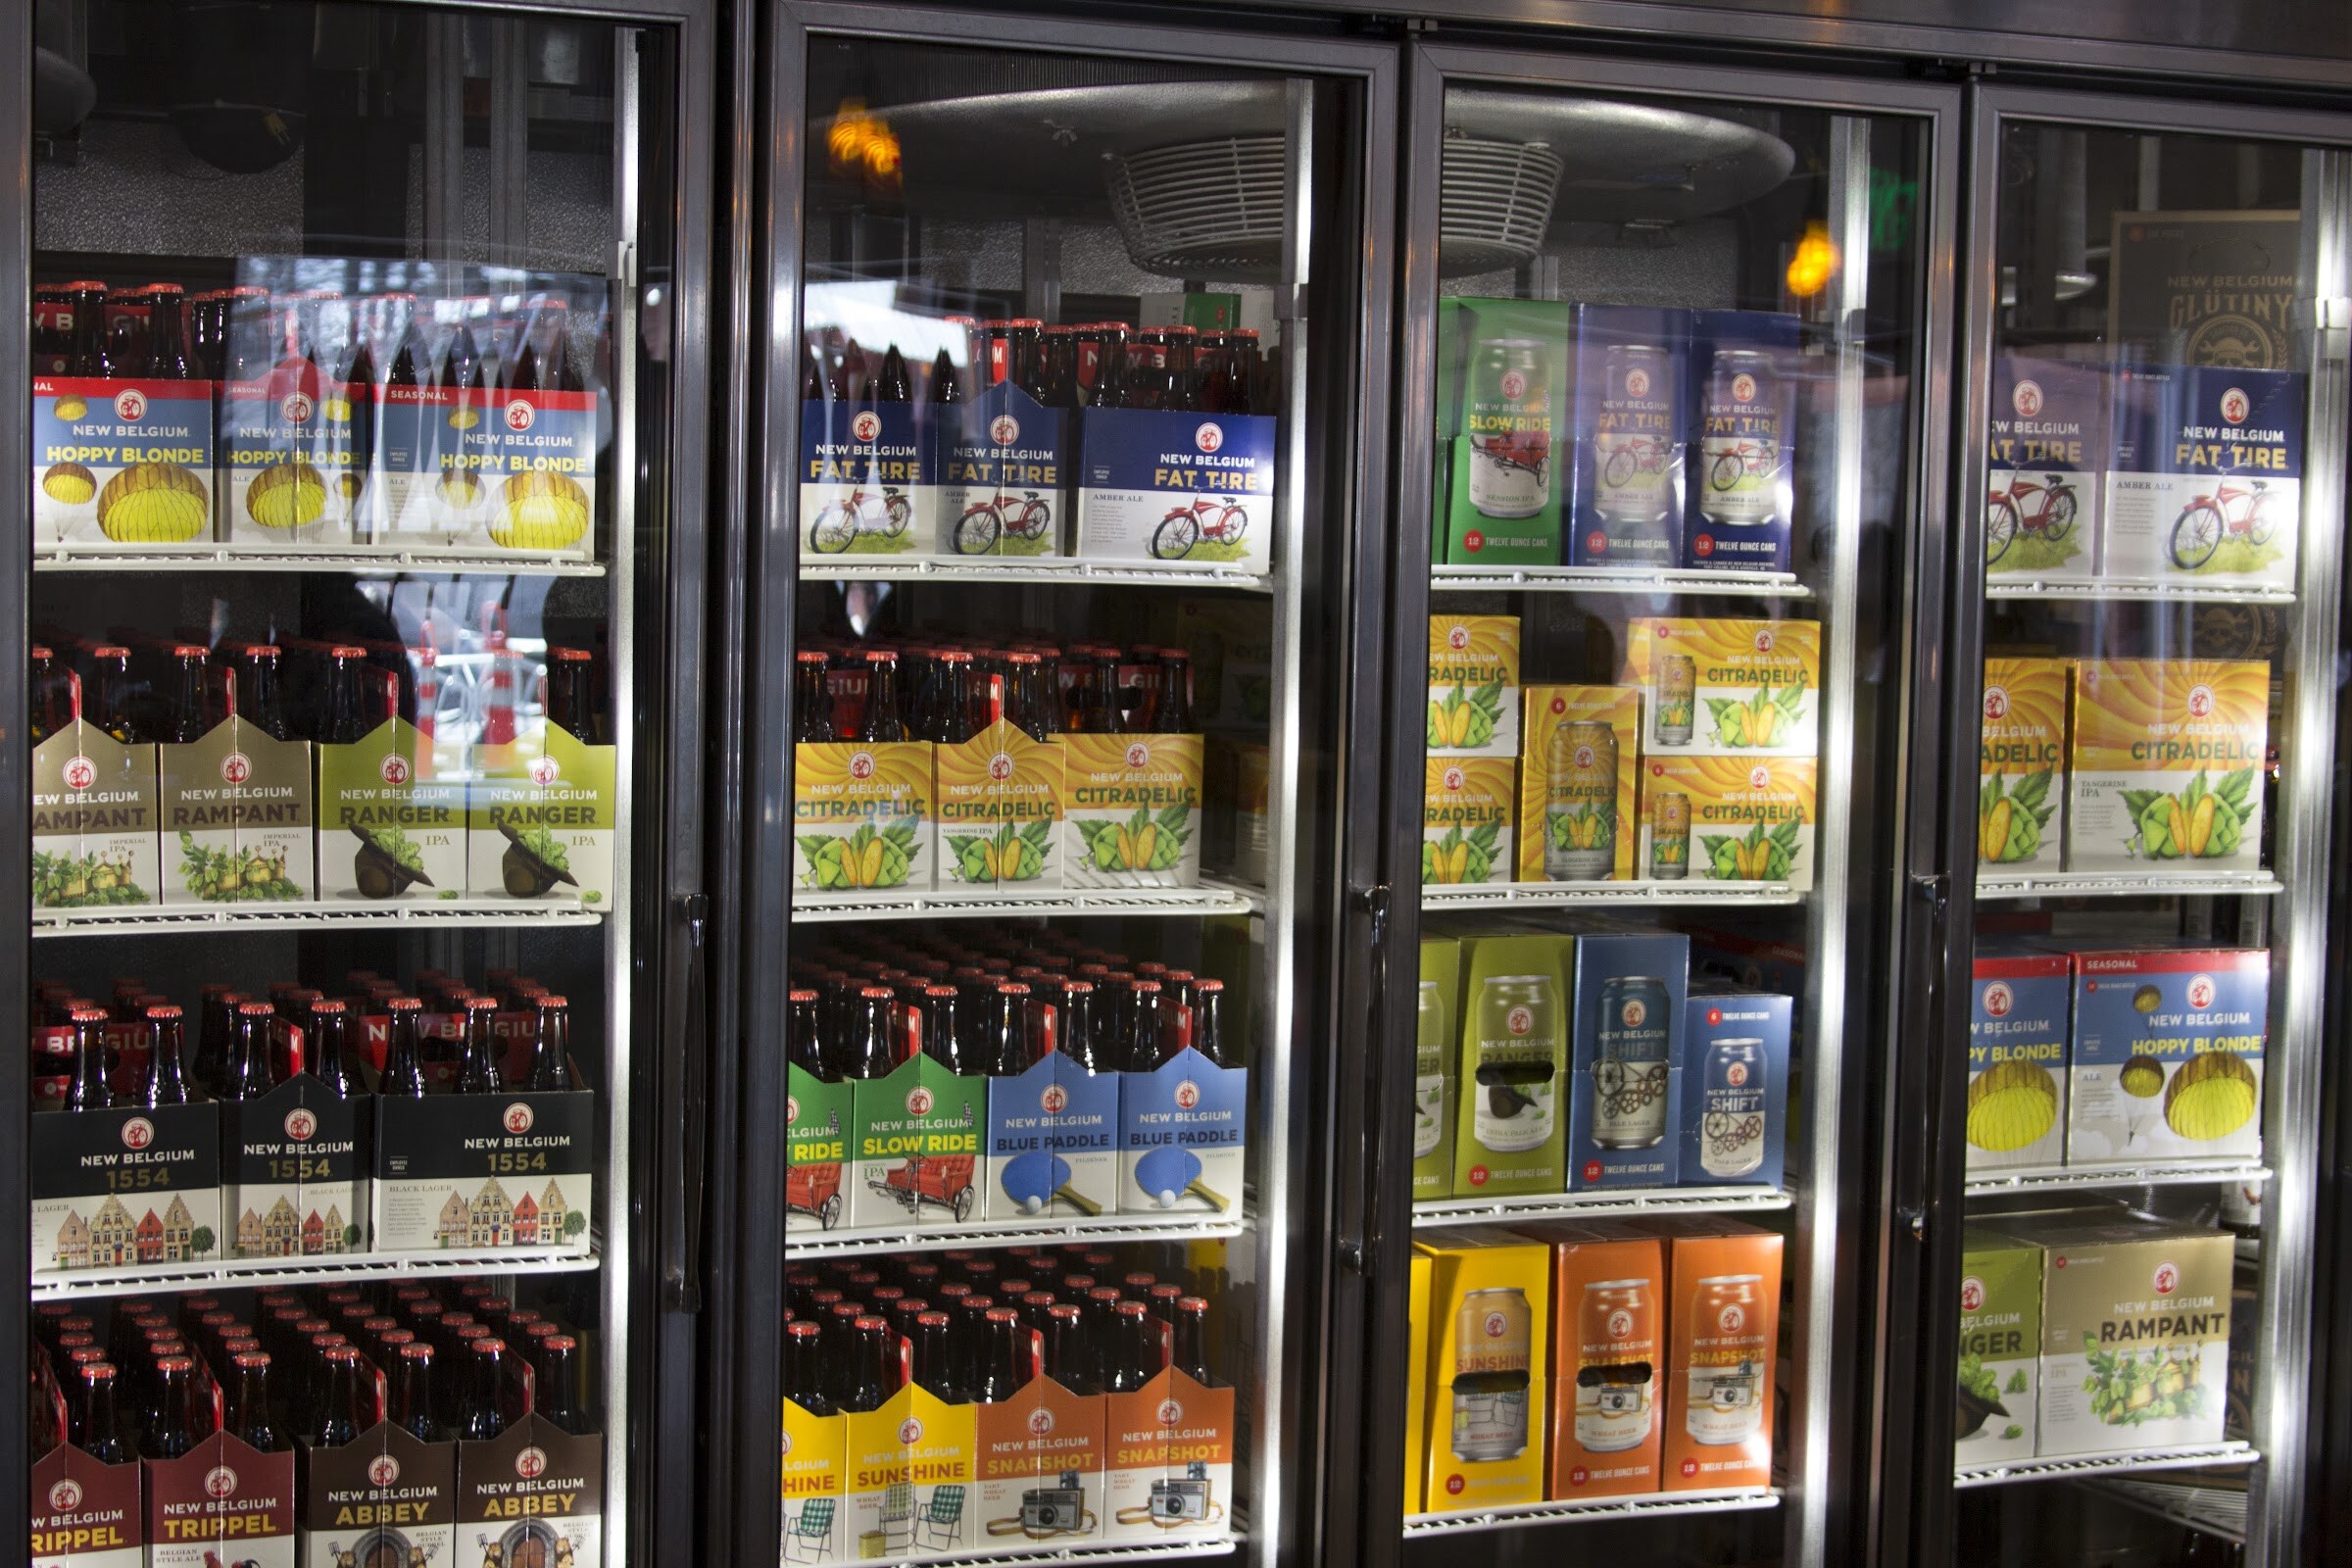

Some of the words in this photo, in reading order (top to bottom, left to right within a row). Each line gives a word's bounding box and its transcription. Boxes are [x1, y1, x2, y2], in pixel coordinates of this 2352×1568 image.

[2169, 276, 2205, 287] NEW
[2213, 275, 2292, 286] BELGIUM
[2170, 290, 2292, 332] GLÜTINY
[390, 390, 448, 401] SEASONAL
[1470, 415, 1513, 431] SLOW
[1516, 416, 1550, 432] RIDE
[1599, 413, 1628, 427] FAT
[1636, 413, 1671, 429] TIRE
[73, 425, 111, 436] NEW
[117, 425, 189, 437] BELGIUM
[240, 427, 277, 438] NEW
[282, 427, 351, 439] BELGIUM
[2183, 426, 2217, 439] NEW
[2222, 428, 2284, 441] BELGIUM
[465, 433, 502, 445] NEW
[505, 434, 573, 447] BELGIUM
[47, 446, 117, 464] HOPPY
[122, 448, 204, 464] BLONDE
[815, 444, 851, 456] NEW
[854, 444, 916, 457] BELGIUM
[954, 447, 987, 459] NEW
[991, 448, 1054, 461] BELGIUM
[2176, 444, 2222, 466] FAT
[2231, 446, 2286, 470] TIRE
[441, 454, 506, 469] HOPPY
[510, 456, 586, 472] BLONDE
[1160, 453, 1193, 465] NEW
[1196, 455, 1255, 467] BELGIUM
[810, 460, 856, 478] FAT
[864, 460, 920, 479] TIRE
[948, 463, 993, 481] FAT
[999, 465, 1056, 483] TIRE
[1154, 468, 1197, 488] FAT
[1205, 470, 1257, 490] TIRE
[2117, 481, 2151, 490] AMBER
[1467, 537, 1479, 546] 12
[1486, 537, 1508, 547] TWELVE
[1510, 538, 1530, 547] OUNCE
[1532, 538, 1547, 547] CANS
[1715, 541, 1739, 550] TWELVE
[1740, 542, 1760, 551] OUNCE
[1760, 542, 1777, 551] CANS
[1754, 656, 1800, 664] BELGIUM
[1707, 667, 1809, 684] CITRADELIC
[2132, 741, 2259, 760] CITRADELIC
[1091, 773, 1122, 782] NEW
[1125, 772, 1183, 782] BELGIUM
[181, 789, 218, 801] NEW
[221, 787, 293, 800] BELGIUM
[341, 789, 377, 800] NEW
[381, 788, 450, 800] BELGIUM
[491, 790, 525, 801] NEW
[529, 789, 598, 801] BELGIUM
[811, 785, 844, 795] NEW
[848, 784, 911, 795] BELGIUM
[951, 785, 983, 795] NEW
[988, 784, 1049, 795] BELGIUM
[1075, 787, 1196, 804] CITRADELIC
[2081, 788, 2099, 797] IPA
[173, 804, 301, 825] RAMPANT
[340, 806, 450, 824] RANGER
[490, 806, 596, 824] RANGER
[795, 799, 926, 816] CITRADELIC
[943, 802, 1054, 817] CITRADELIC
[1703, 805, 1804, 819] CITRADELIC
[425, 835, 450, 846] IPA
[572, 835, 596, 846] IPA
[2086, 960, 2137, 969] SEASONAL
[2149, 1014, 2182, 1026] NEW
[2186, 1012, 2249, 1025] BELGIUM
[1984, 1020, 2048, 1034] BELGIUM
[1599, 1031, 1620, 1040] NEW
[1623, 1030, 1666, 1039] BELGIUM
[1991, 1044, 2061, 1061] BLONDE
[2132, 1038, 2189, 1054] HOPPY
[2193, 1036, 2262, 1053] BLONDE
[1712, 1097, 1758, 1111] SHIFT
[1006, 1117, 1037, 1128] NEW
[1041, 1115, 1102, 1126] BELGIUM
[1140, 1112, 1169, 1123] NEW
[1175, 1110, 1231, 1121] BELGIUM
[871, 1121, 903, 1131] NEW
[906, 1119, 968, 1130] BELGIUM
[465, 1138, 499, 1150] NEW
[504, 1136, 570, 1148] BELGIUM
[863, 1136, 922, 1154] SLOW
[928, 1134, 977, 1152] RIDE
[997, 1137, 1039, 1151] BLUE
[1044, 1134, 1109, 1148] PADDLE
[1131, 1132, 1172, 1145] BLUE
[1178, 1129, 1238, 1143] PADDLE
[244, 1145, 281, 1154] NEW
[285, 1142, 354, 1155] BELGIUM
[795, 1142, 843, 1160] RIDE
[80, 1154, 118, 1166] NEW
[122, 1150, 195, 1164] BELGIUM
[488, 1152, 546, 1172] 1554
[269, 1158, 330, 1179] 1554
[1491, 1170, 1512, 1179] TWELVE
[1515, 1168, 1535, 1178] OUNCE
[1537, 1167, 1552, 1177] CANS
[1604, 1165, 1626, 1174] TWELVE
[1628, 1164, 1646, 1173] OUNCE
[1648, 1163, 1664, 1172] CANS
[106, 1167, 170, 1189] 1554
[37, 1204, 70, 1213] LAGER
[2114, 1302, 2147, 1314] NEW
[2151, 1297, 2215, 1311] BELGIUM
[2100, 1313, 2225, 1343] RAMPANT
[1584, 1344, 1607, 1352] NEW
[1611, 1341, 1652, 1351] BELGIUM
[1694, 1338, 1718, 1347] NEW
[1721, 1335, 1763, 1345] BELGIUM
[1690, 1348, 1764, 1364] SNAPSHOT
[1123, 1432, 1152, 1442] NEW
[1157, 1428, 1216, 1440] BELGIUM
[993, 1442, 1023, 1452] NEW
[1028, 1437, 1089, 1450] BELGIUM
[862, 1452, 894, 1464] NEW
[899, 1446, 959, 1460] BELGIUM
[1117, 1445, 1221, 1464] SNAPSHOT
[987, 1452, 1095, 1475] SNAPSHOT
[858, 1462, 965, 1487] SUNSHINE
[477, 1483, 513, 1494] NEW
[515, 1478, 584, 1493] BELGIUM
[1450, 1480, 1460, 1489] 12
[328, 1491, 365, 1501] NEW
[368, 1487, 437, 1499] BELGIUM
[164, 1503, 201, 1515] NEW
[206, 1497, 276, 1512] BELGIUM
[484, 1494, 576, 1517] ABBEY
[51, 1510, 122, 1527] BELGIUM
[335, 1502, 429, 1526] ABBEY
[164, 1515, 276, 1539] TRIPPEL
